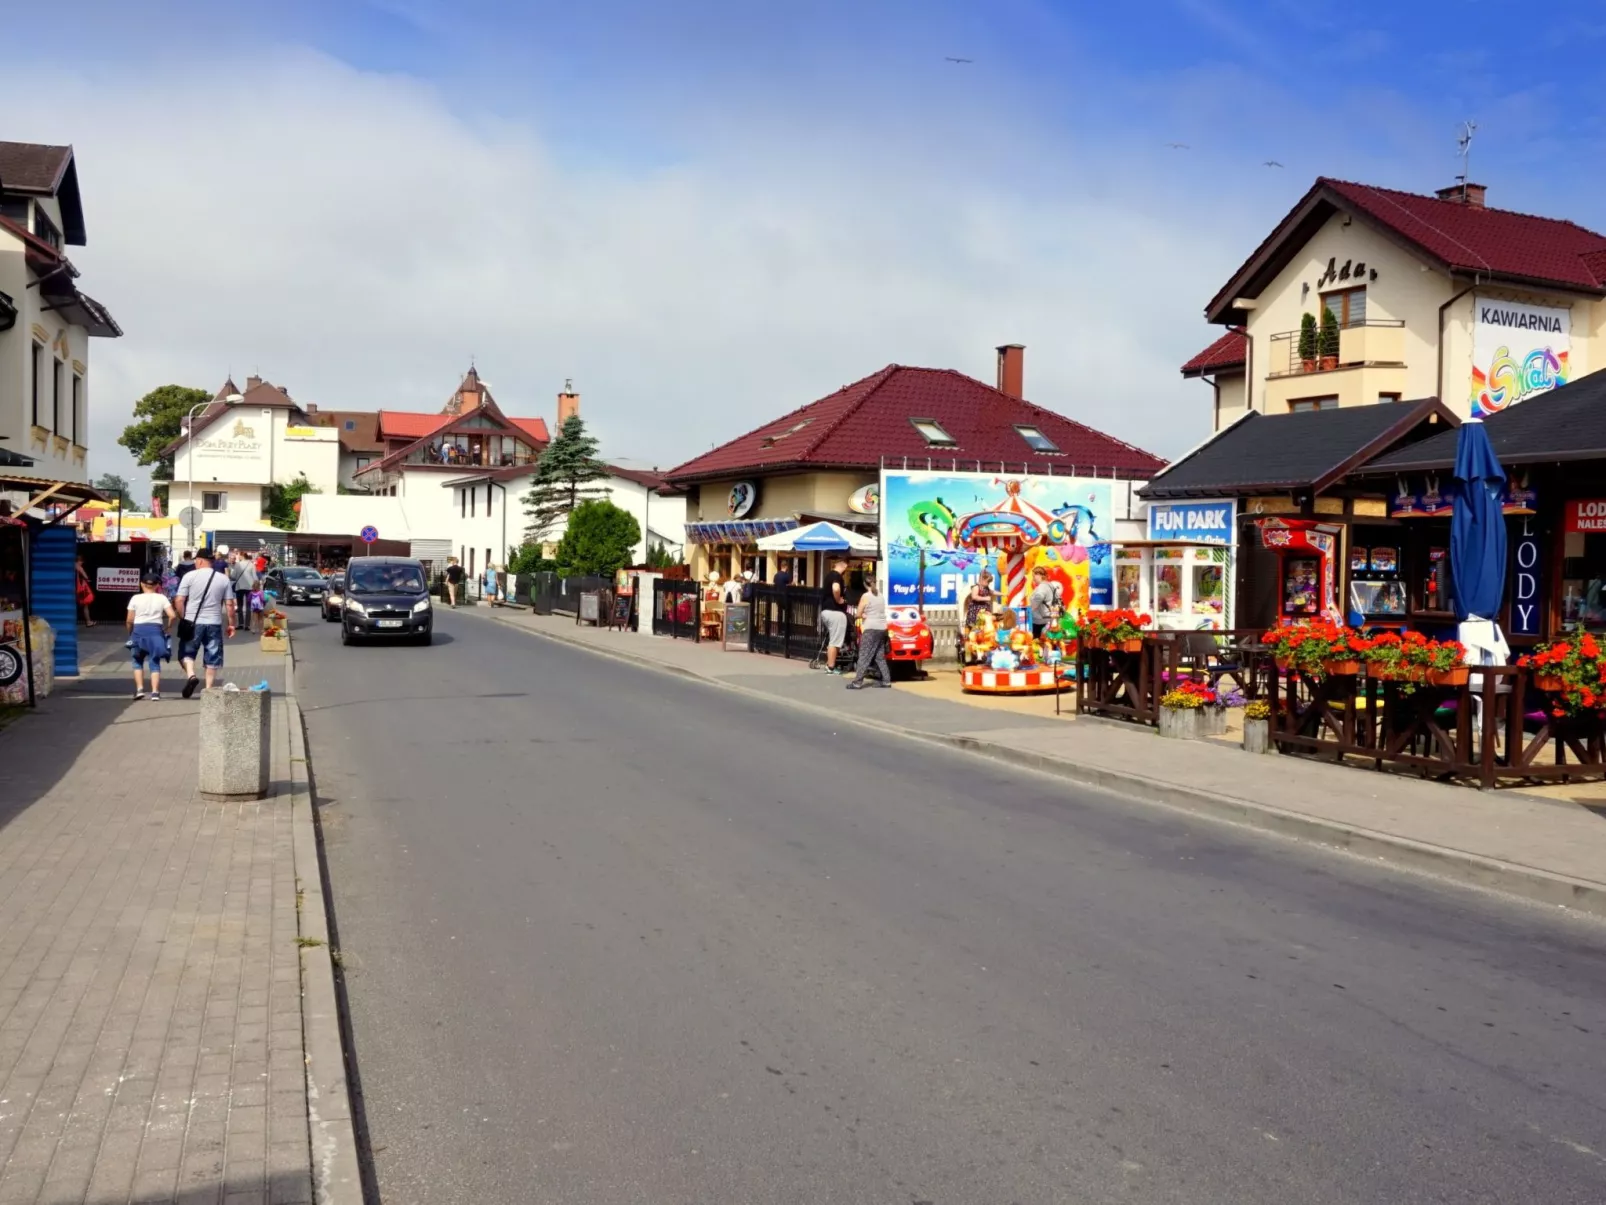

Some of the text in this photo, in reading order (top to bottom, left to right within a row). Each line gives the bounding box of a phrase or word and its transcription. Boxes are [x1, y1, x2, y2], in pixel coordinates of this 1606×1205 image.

[1318, 257, 1366, 288] Ada
[1481, 307, 1562, 333] KAWIARNIA
[1155, 510, 1227, 531] FUN PARK
[1517, 516, 1537, 631] LODY
